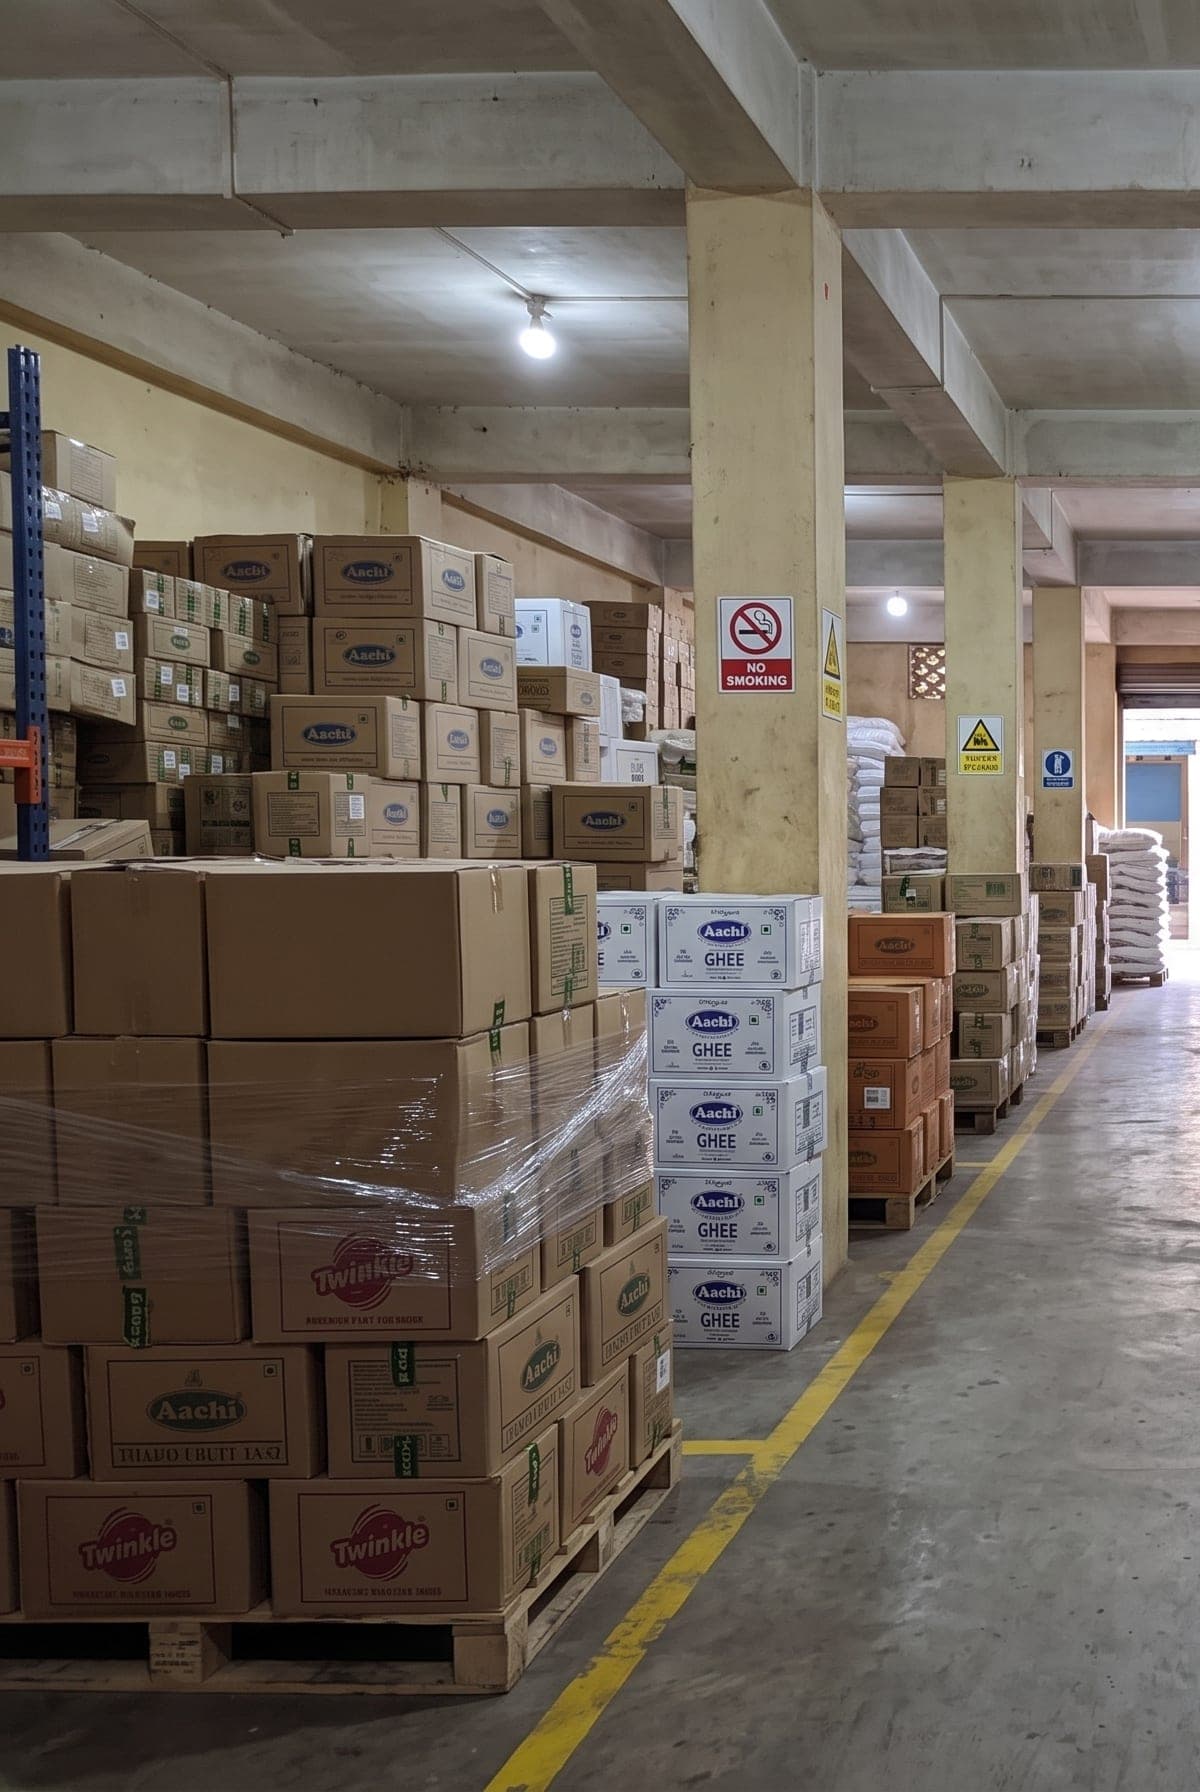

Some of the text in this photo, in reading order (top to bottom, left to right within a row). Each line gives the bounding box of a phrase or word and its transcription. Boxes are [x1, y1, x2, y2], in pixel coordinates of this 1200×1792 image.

[746, 662, 766, 673] NO
[726, 675, 788, 686] SMOKING
[704, 924, 746, 938] Aachi
[704, 952, 745, 967] GHEE
[691, 1013, 734, 1028] Aachi
[692, 1042, 732, 1058] GHEE
[694, 1105, 738, 1120] Aachi
[697, 1133, 737, 1149] GHEE
[695, 1194, 739, 1209] Aachi
[697, 1222, 738, 1239] GHEE
[314, 1254, 413, 1293] Twinkle
[697, 1284, 741, 1299] Aachi
[701, 1312, 740, 1328] GHEE
[524, 1345, 560, 1386] Aachi
[156, 1397, 238, 1421] Aachi
[81, 1528, 176, 1568] Twinkle
[334, 1524, 427, 1565] Twinkle
